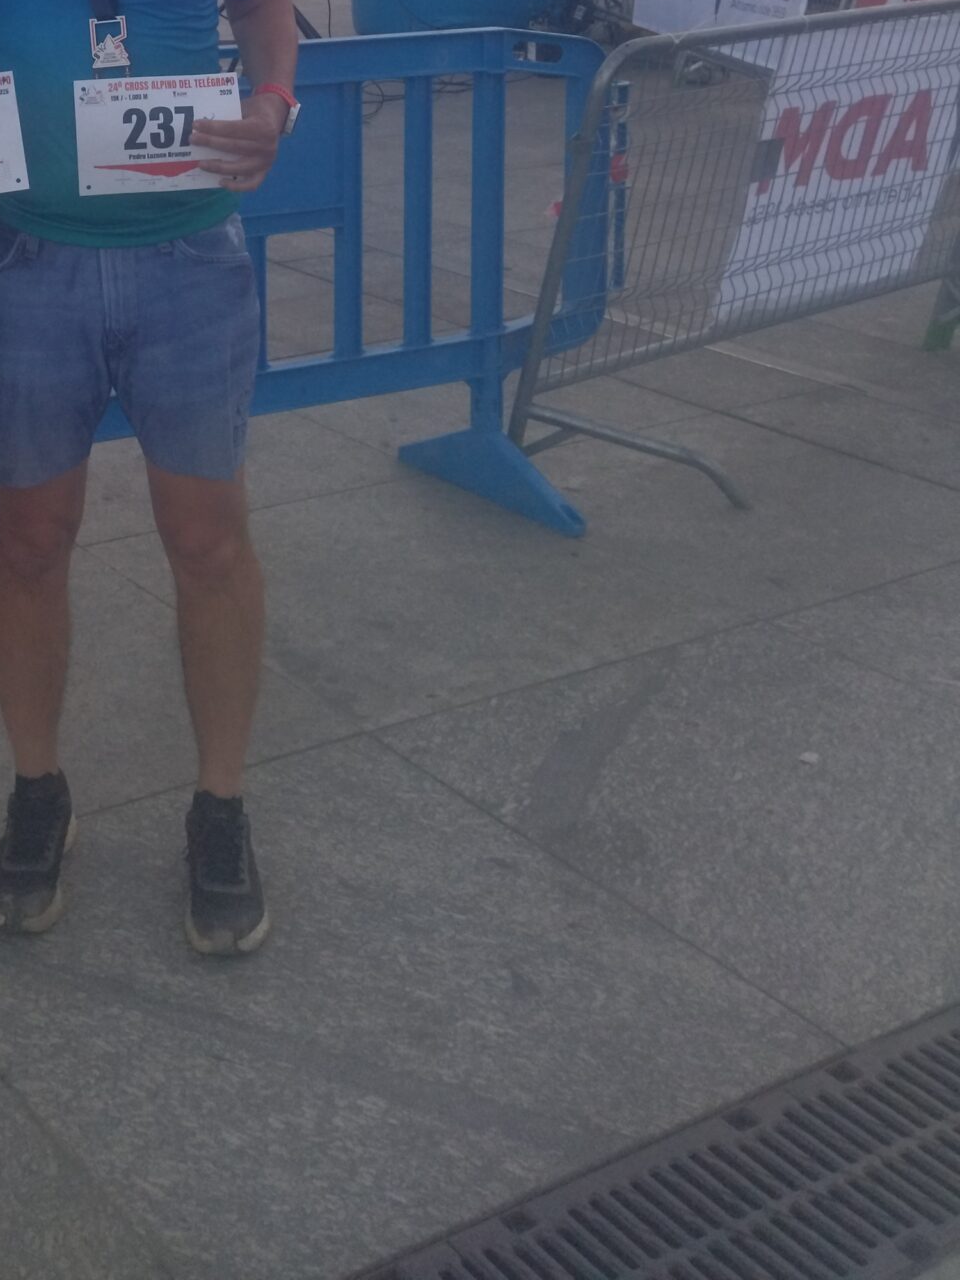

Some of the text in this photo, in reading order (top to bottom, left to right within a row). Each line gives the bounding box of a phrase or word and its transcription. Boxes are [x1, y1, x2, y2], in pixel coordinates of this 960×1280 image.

[124, 80, 150, 92] CROSS
[151, 79, 178, 91] ALPINO
[179, 79, 192, 90] DEL
[122, 105, 195, 151] 237
